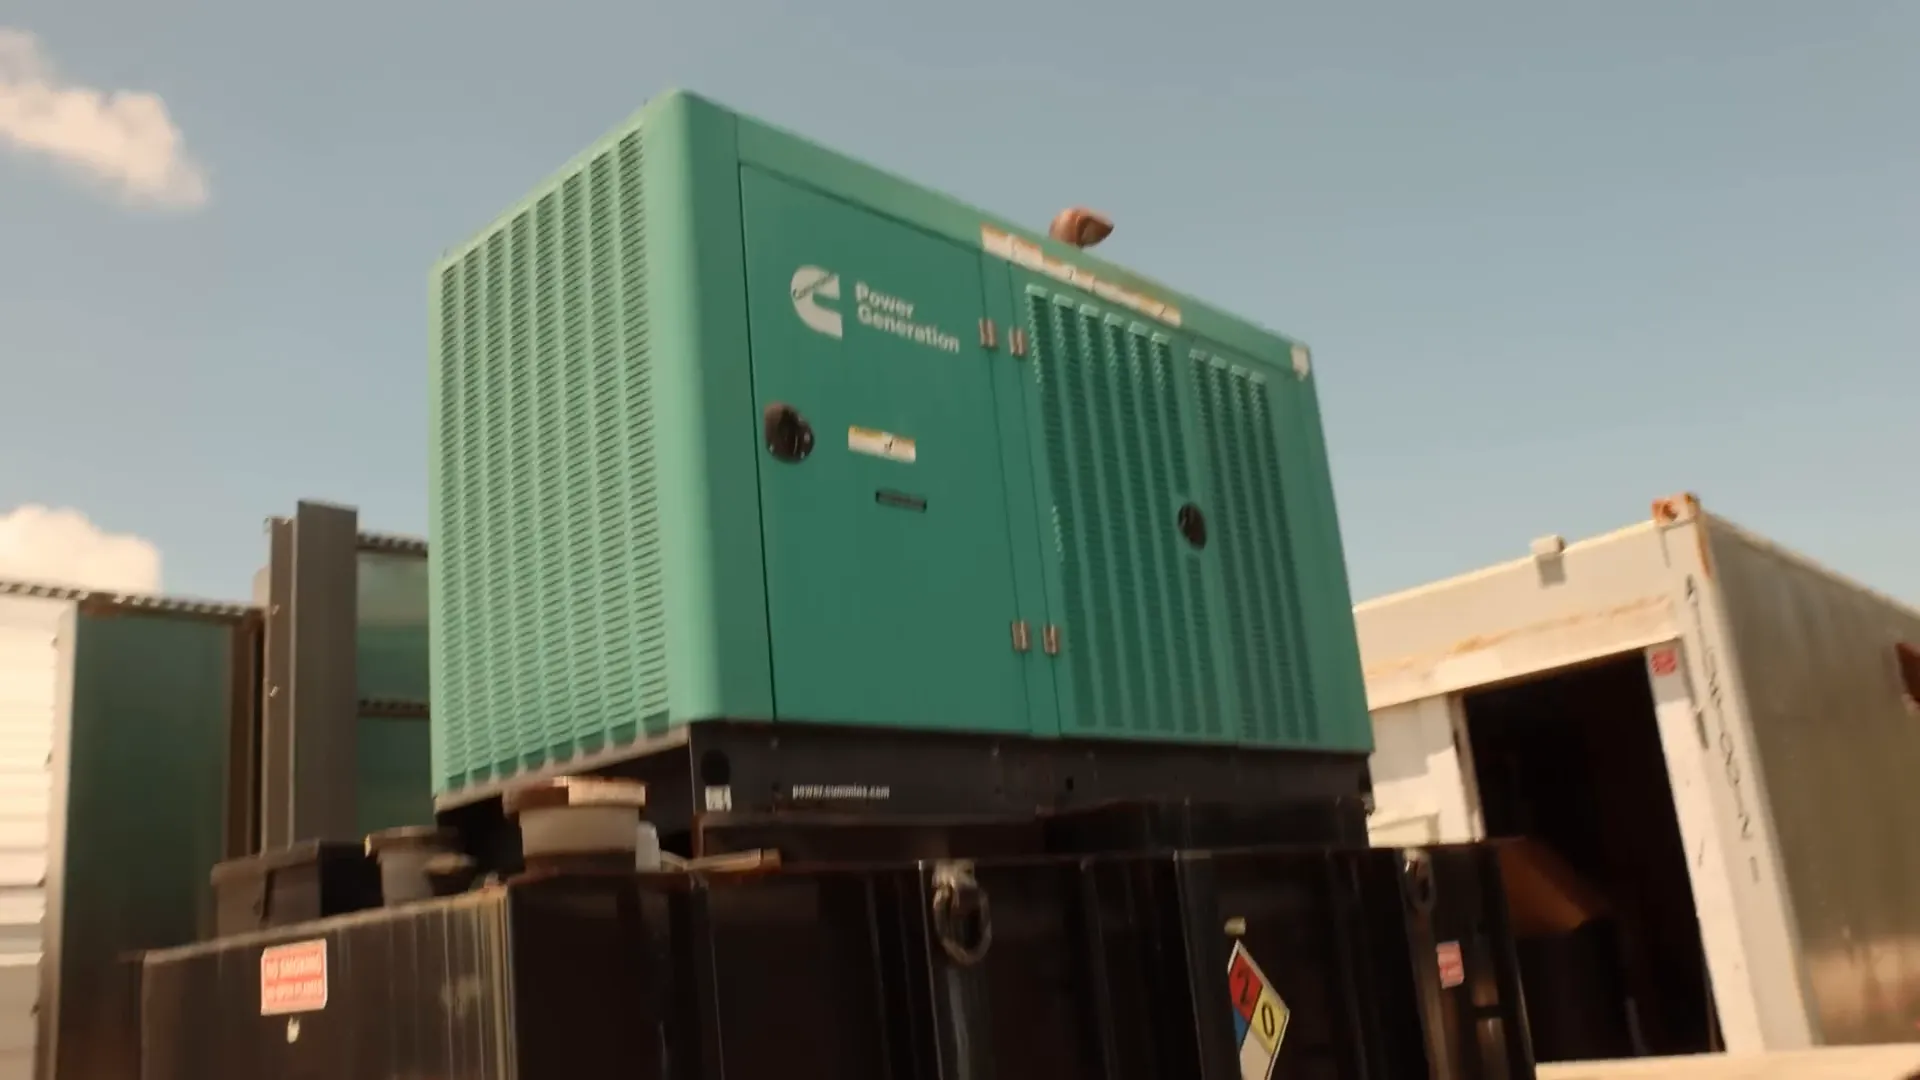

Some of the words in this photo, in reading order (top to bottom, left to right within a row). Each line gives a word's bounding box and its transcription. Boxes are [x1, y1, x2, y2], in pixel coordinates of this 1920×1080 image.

[856, 281, 914, 319] Power
[857, 303, 960, 354] Generation
[1261, 1001, 1276, 1038] 0
